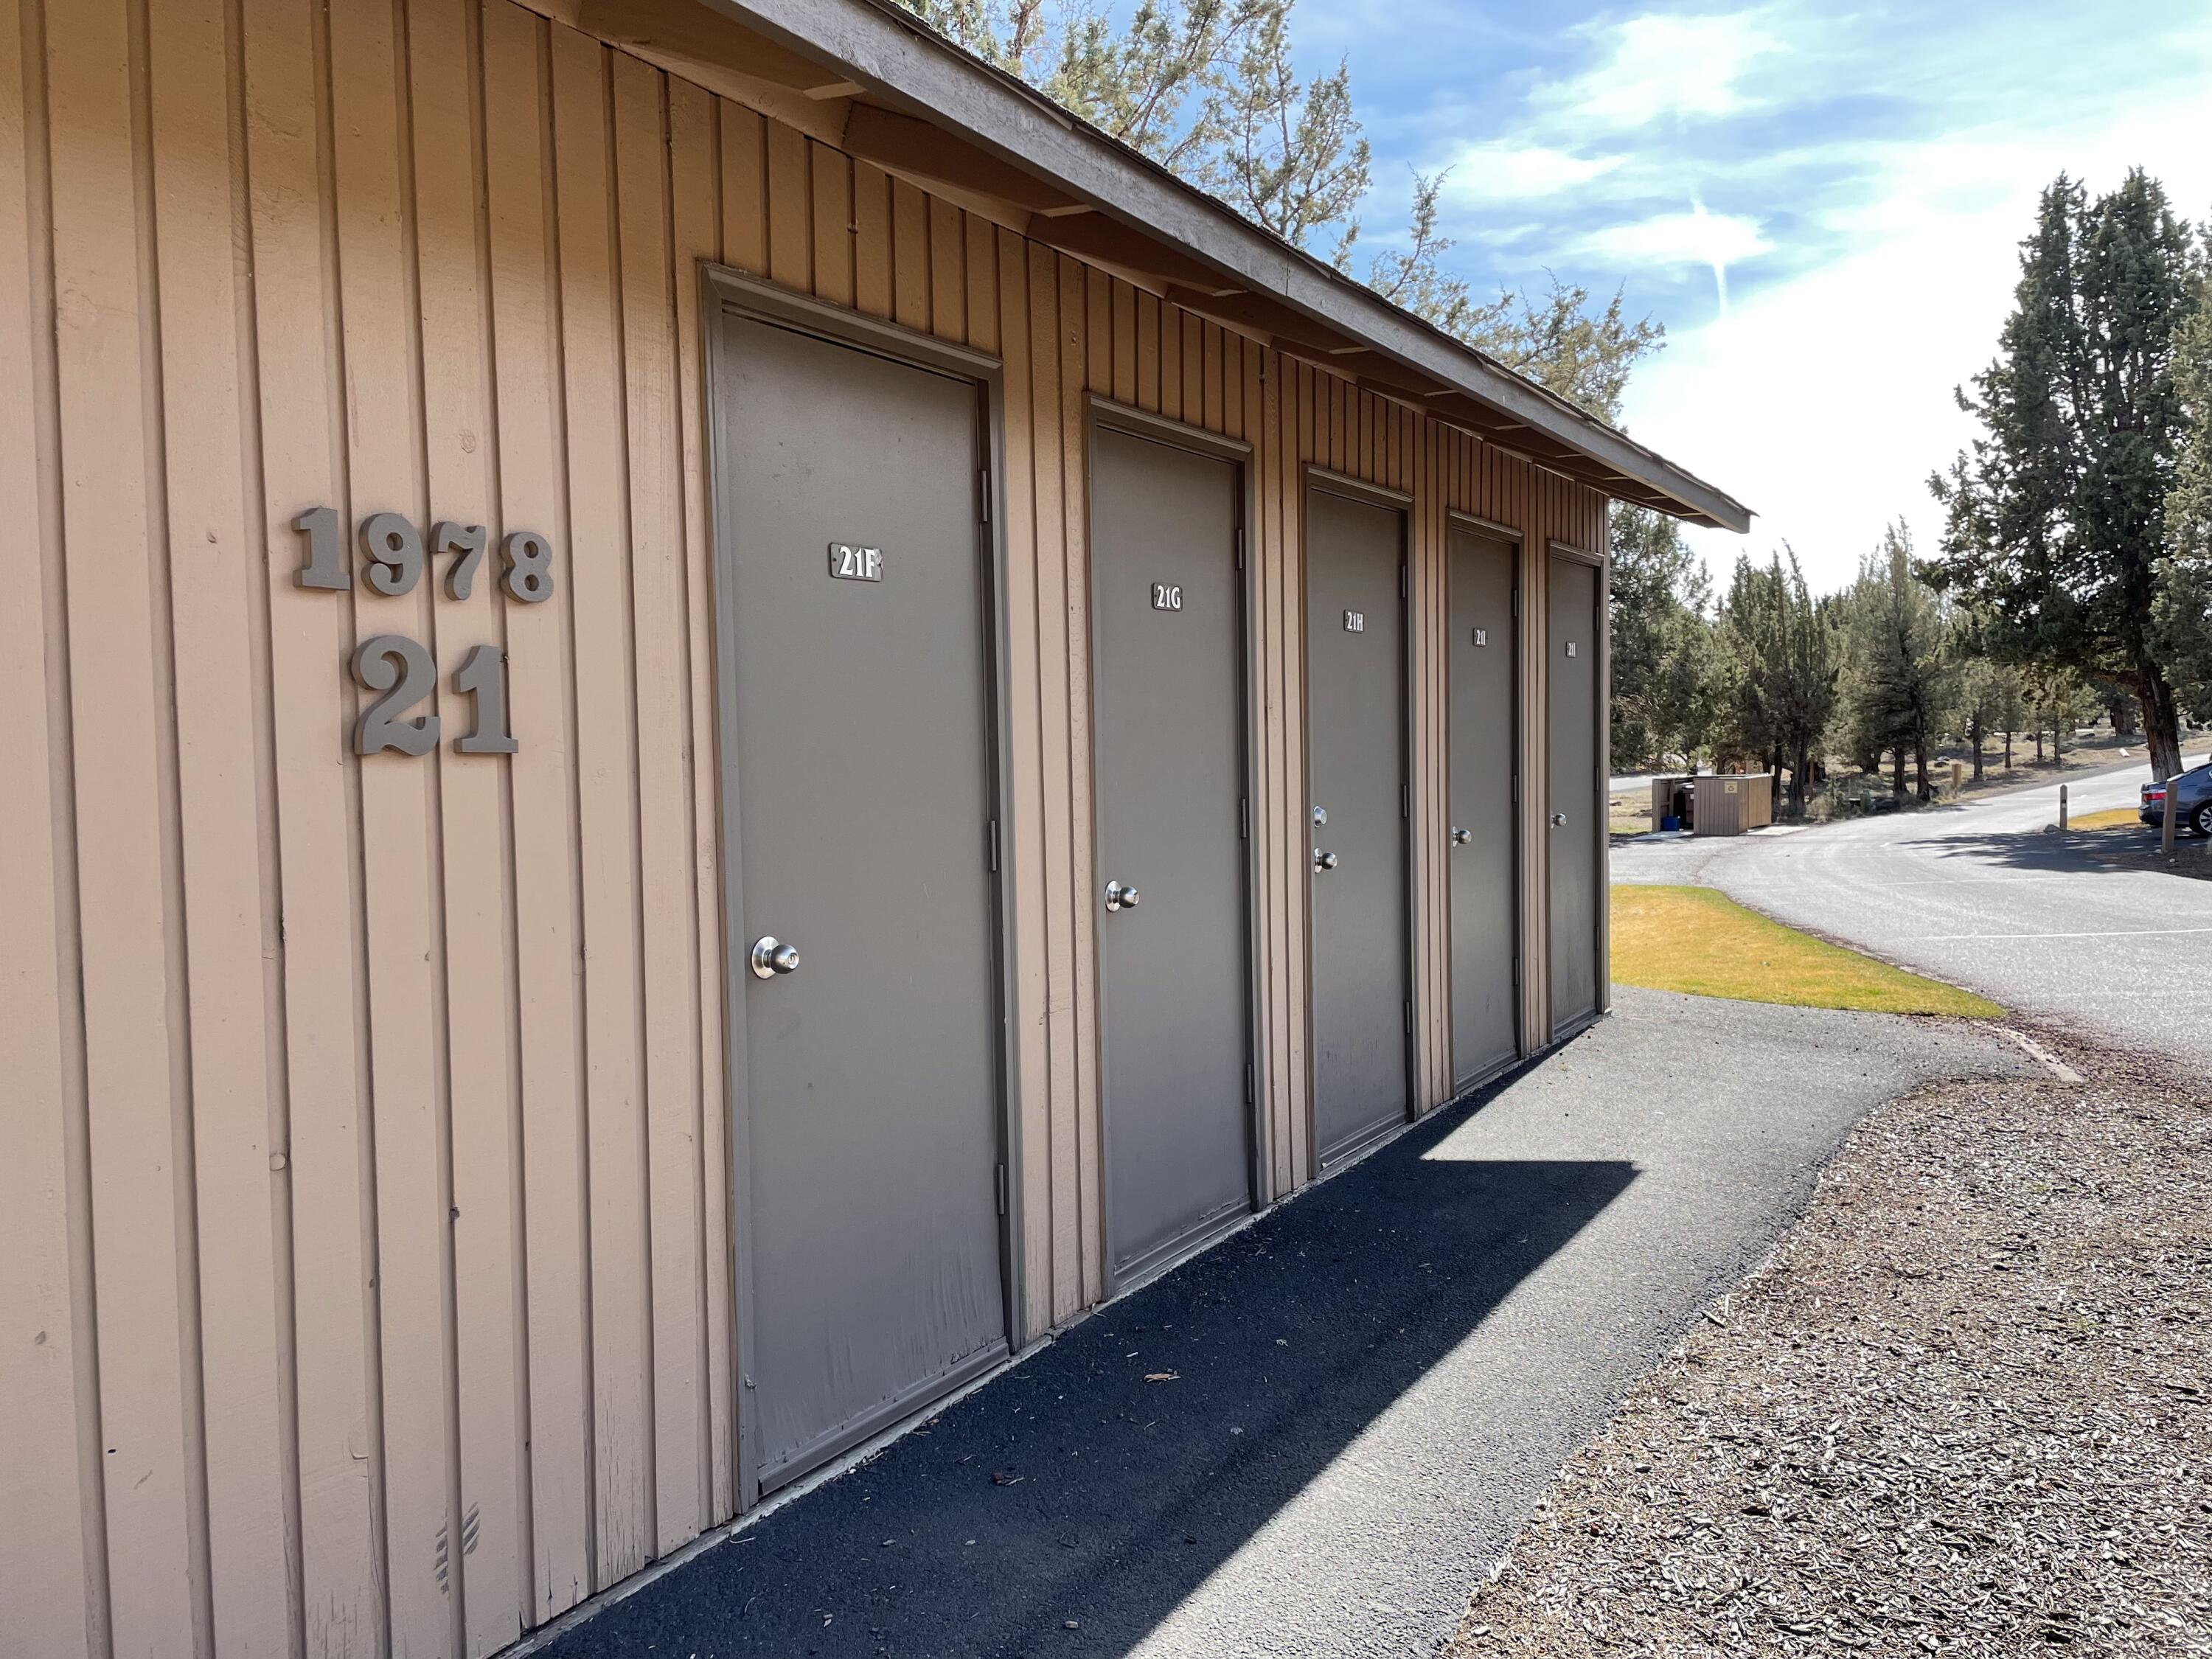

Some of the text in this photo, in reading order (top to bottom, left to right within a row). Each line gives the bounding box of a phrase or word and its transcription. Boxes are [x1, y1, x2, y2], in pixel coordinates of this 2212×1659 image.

[291, 507, 554, 603] 1978
[839, 546, 876, 578] 21F
[1156, 585, 1180, 609] 21G
[1346, 611, 1363, 632] 21H
[350, 635, 518, 756] 21
